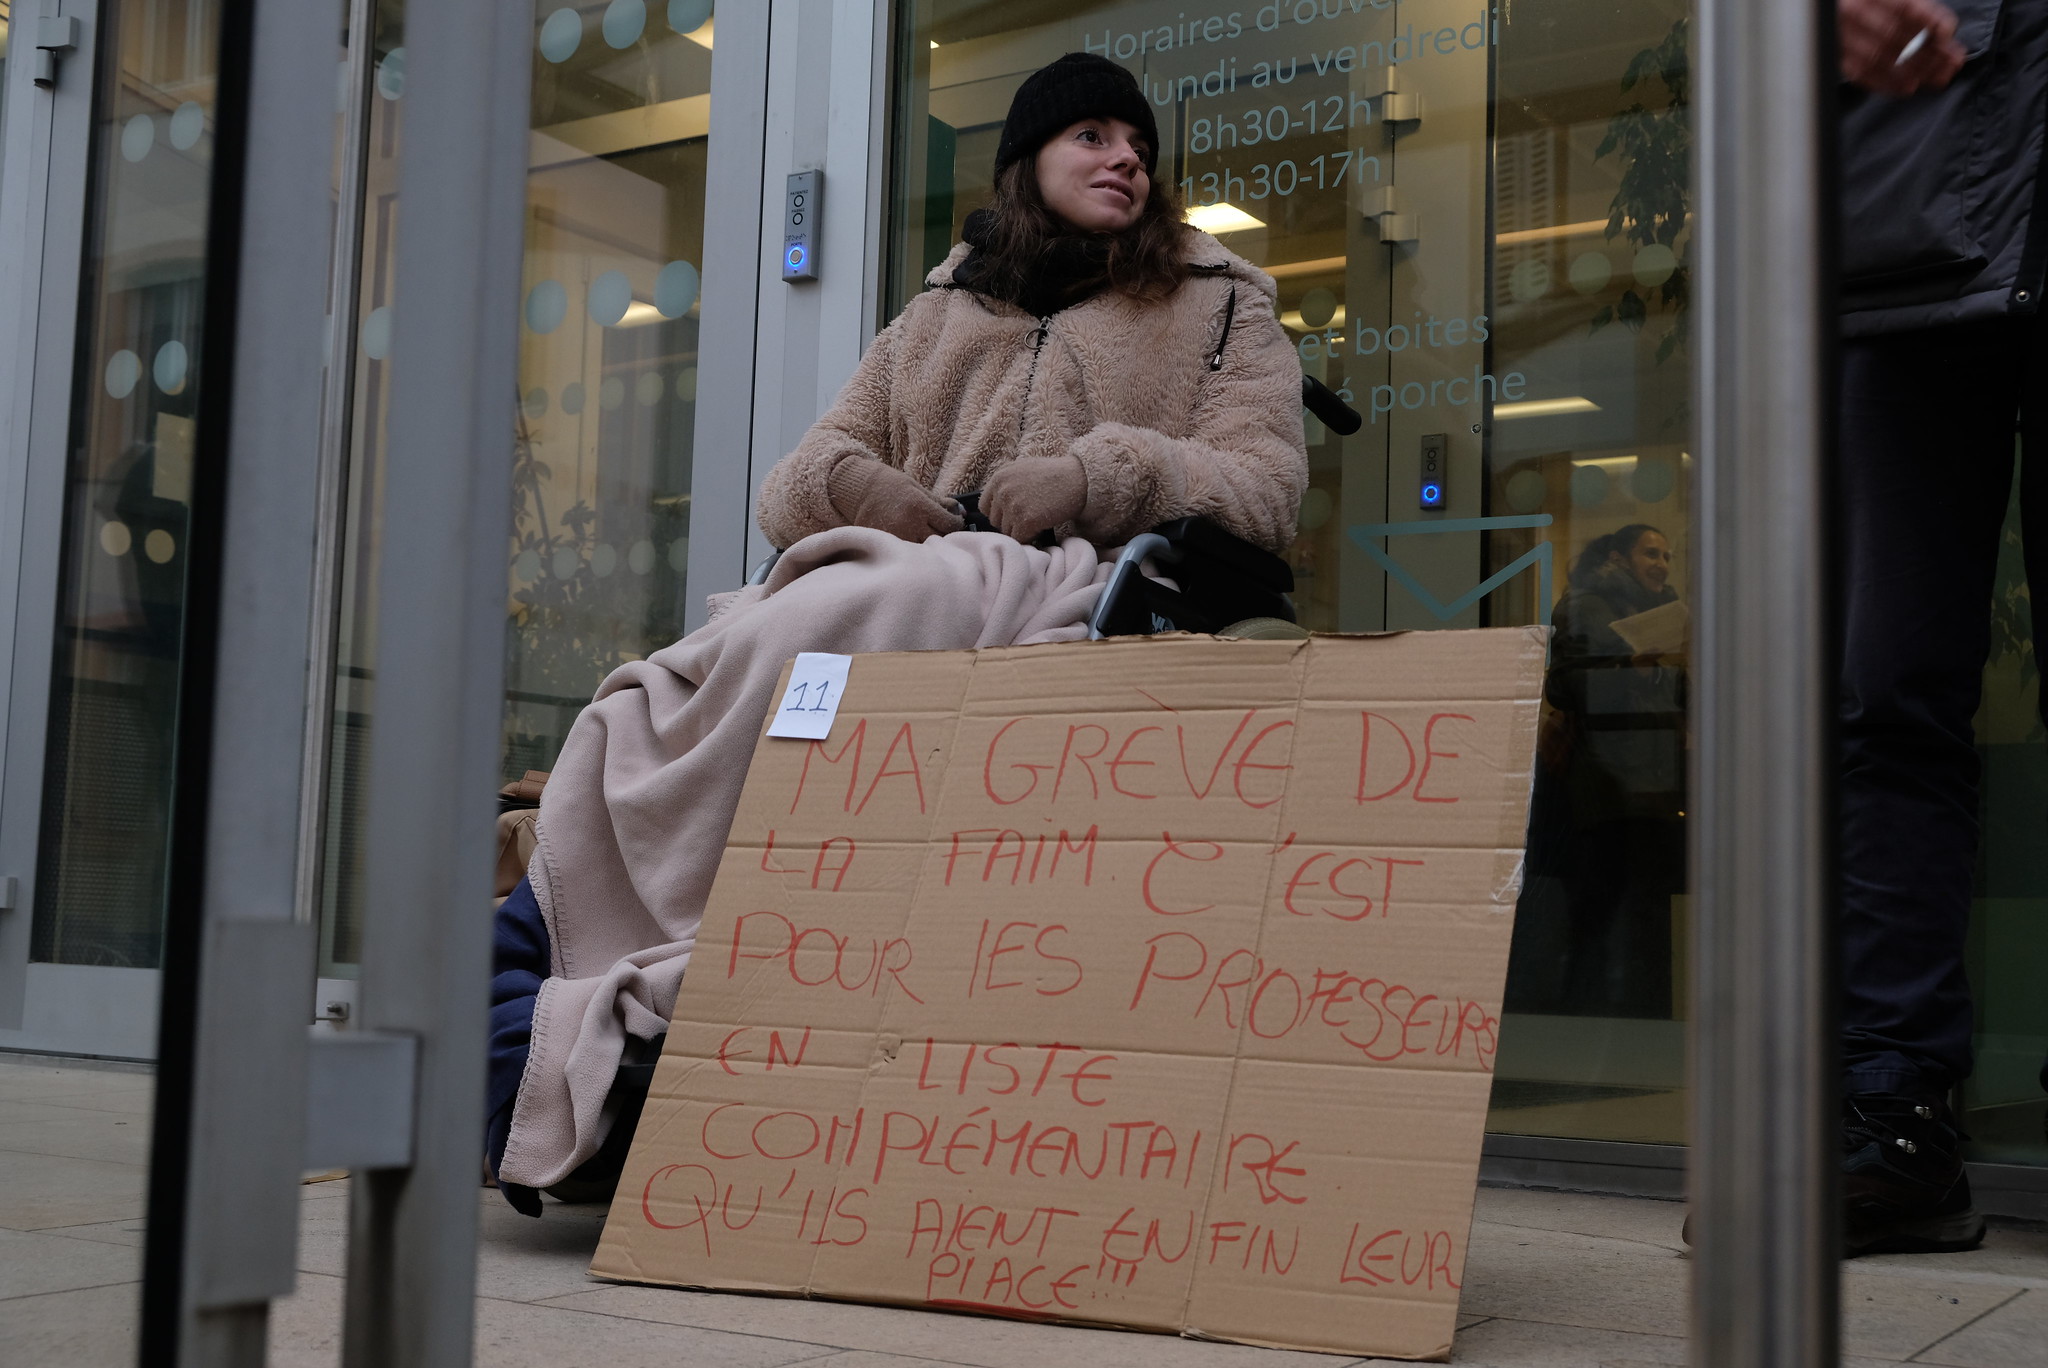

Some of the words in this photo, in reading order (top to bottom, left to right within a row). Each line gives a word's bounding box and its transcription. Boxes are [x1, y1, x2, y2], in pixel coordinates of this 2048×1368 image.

[1085, 12, 1242, 60] Horaires
[1143, 56, 1237, 107] lundi
[1251, 57, 1297, 89] au
[1311, 8, 1499, 77] vendredi
[1189, 94, 1372, 154] 8h30-12h
[1179, 147, 1381, 208] 13h30-17h
[1299, 327, 1341, 361] et
[1355, 311, 1490, 356] boites
[1370, 364, 1527, 425] porche
[786, 681, 830, 712] 11
[790, 718, 925, 816] MA
[1355, 711, 1475, 805] DE
[761, 829, 856, 892] LA
[728, 911, 925, 1004] POUR
[1129, 932, 1499, 1070] PROFESSEURS
[716, 1026, 812, 1076] EN
[918, 1037, 1118, 1107] LISTE
[906, 1198, 1080, 1260] AIENT
[1340, 1223, 1461, 1290] LEUR
